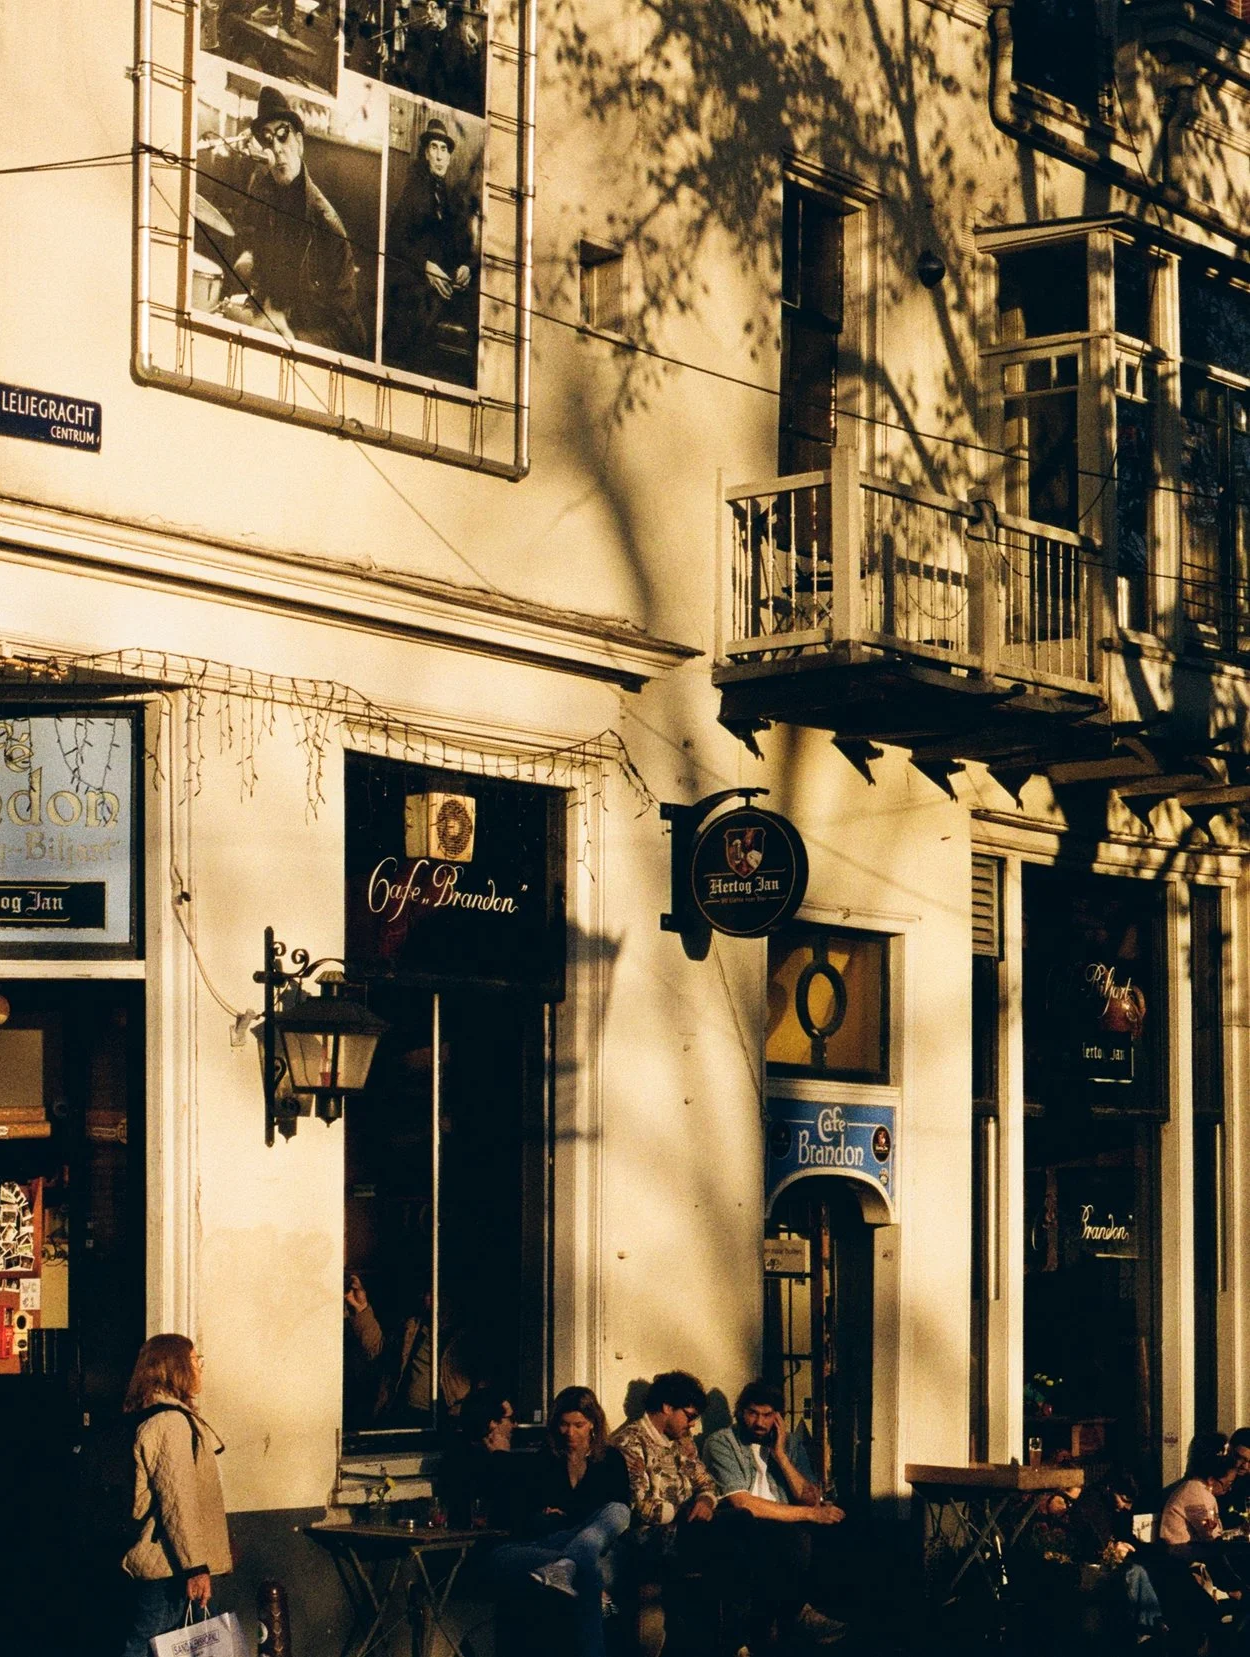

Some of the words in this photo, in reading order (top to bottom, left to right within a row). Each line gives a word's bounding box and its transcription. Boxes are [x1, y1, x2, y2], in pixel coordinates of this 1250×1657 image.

[1, 391, 95, 428] LELIEGRACHT
[50, 425, 95, 445] CENTRUM
[25, 890, 64, 916] Jan
[368, 857, 430, 922] Cafe
[709, 879, 752, 898] Hertog
[754, 876, 779, 897] Jan
[818, 1106, 846, 1143] Cafe
[798, 1129, 864, 1167] Brandon
